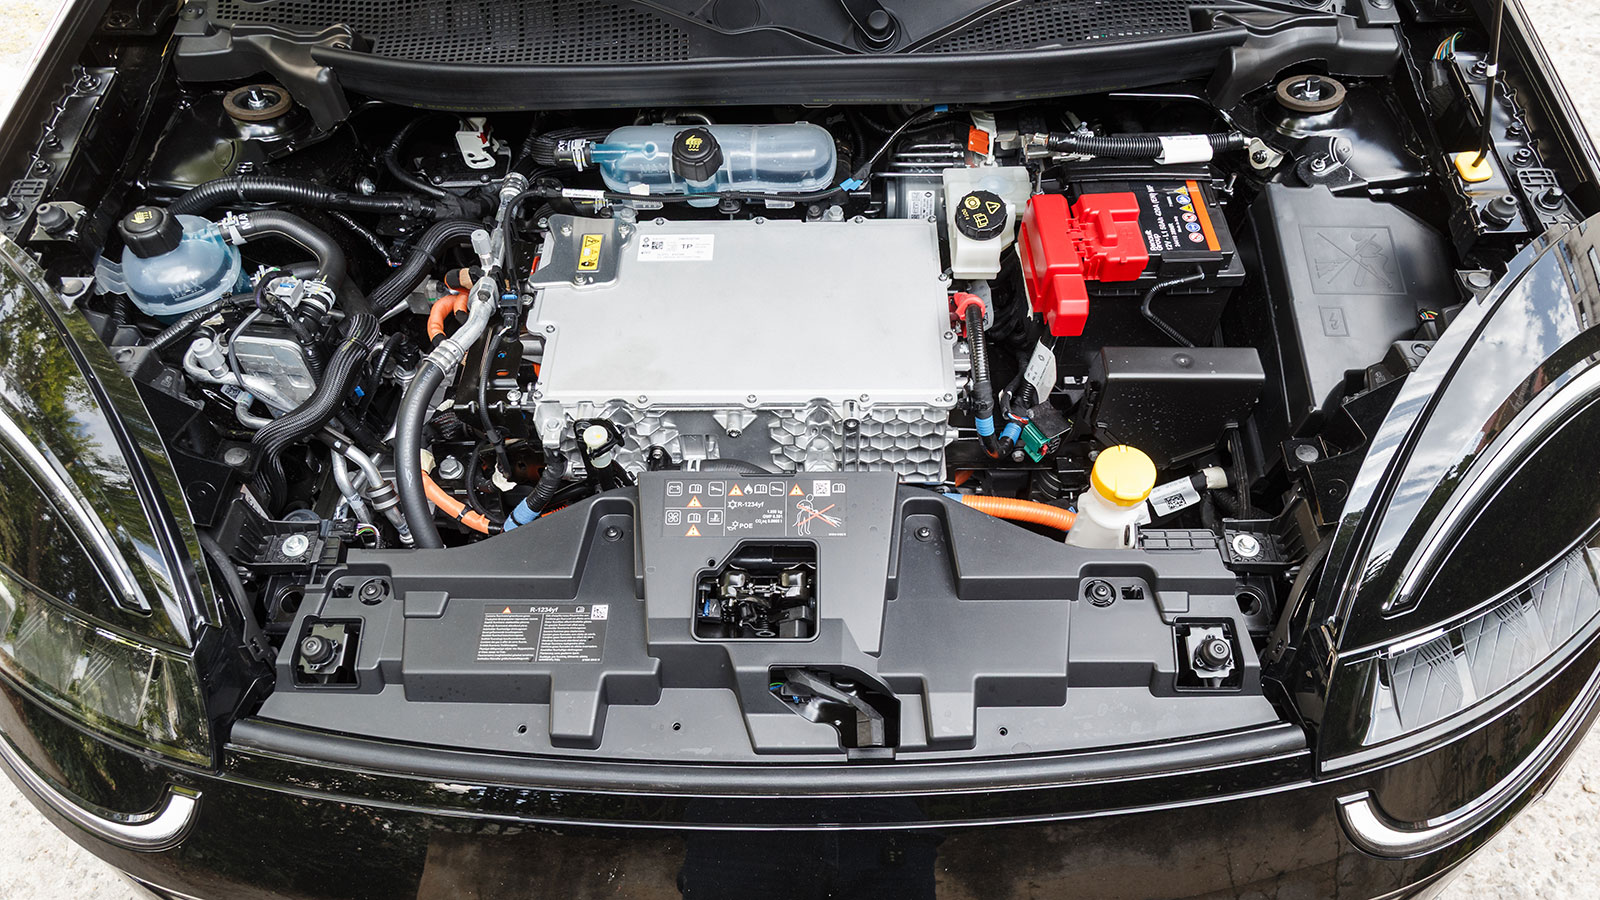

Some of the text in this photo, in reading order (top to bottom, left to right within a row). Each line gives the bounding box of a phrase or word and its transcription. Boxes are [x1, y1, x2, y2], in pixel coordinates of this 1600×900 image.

[640, 162, 669, 174] MAX
[1153, 233, 1163, 251] Group
[168, 279, 204, 298] MAX
[737, 501, 764, 509] R-1234yf
[529, 606, 559, 614] R-1234yf
